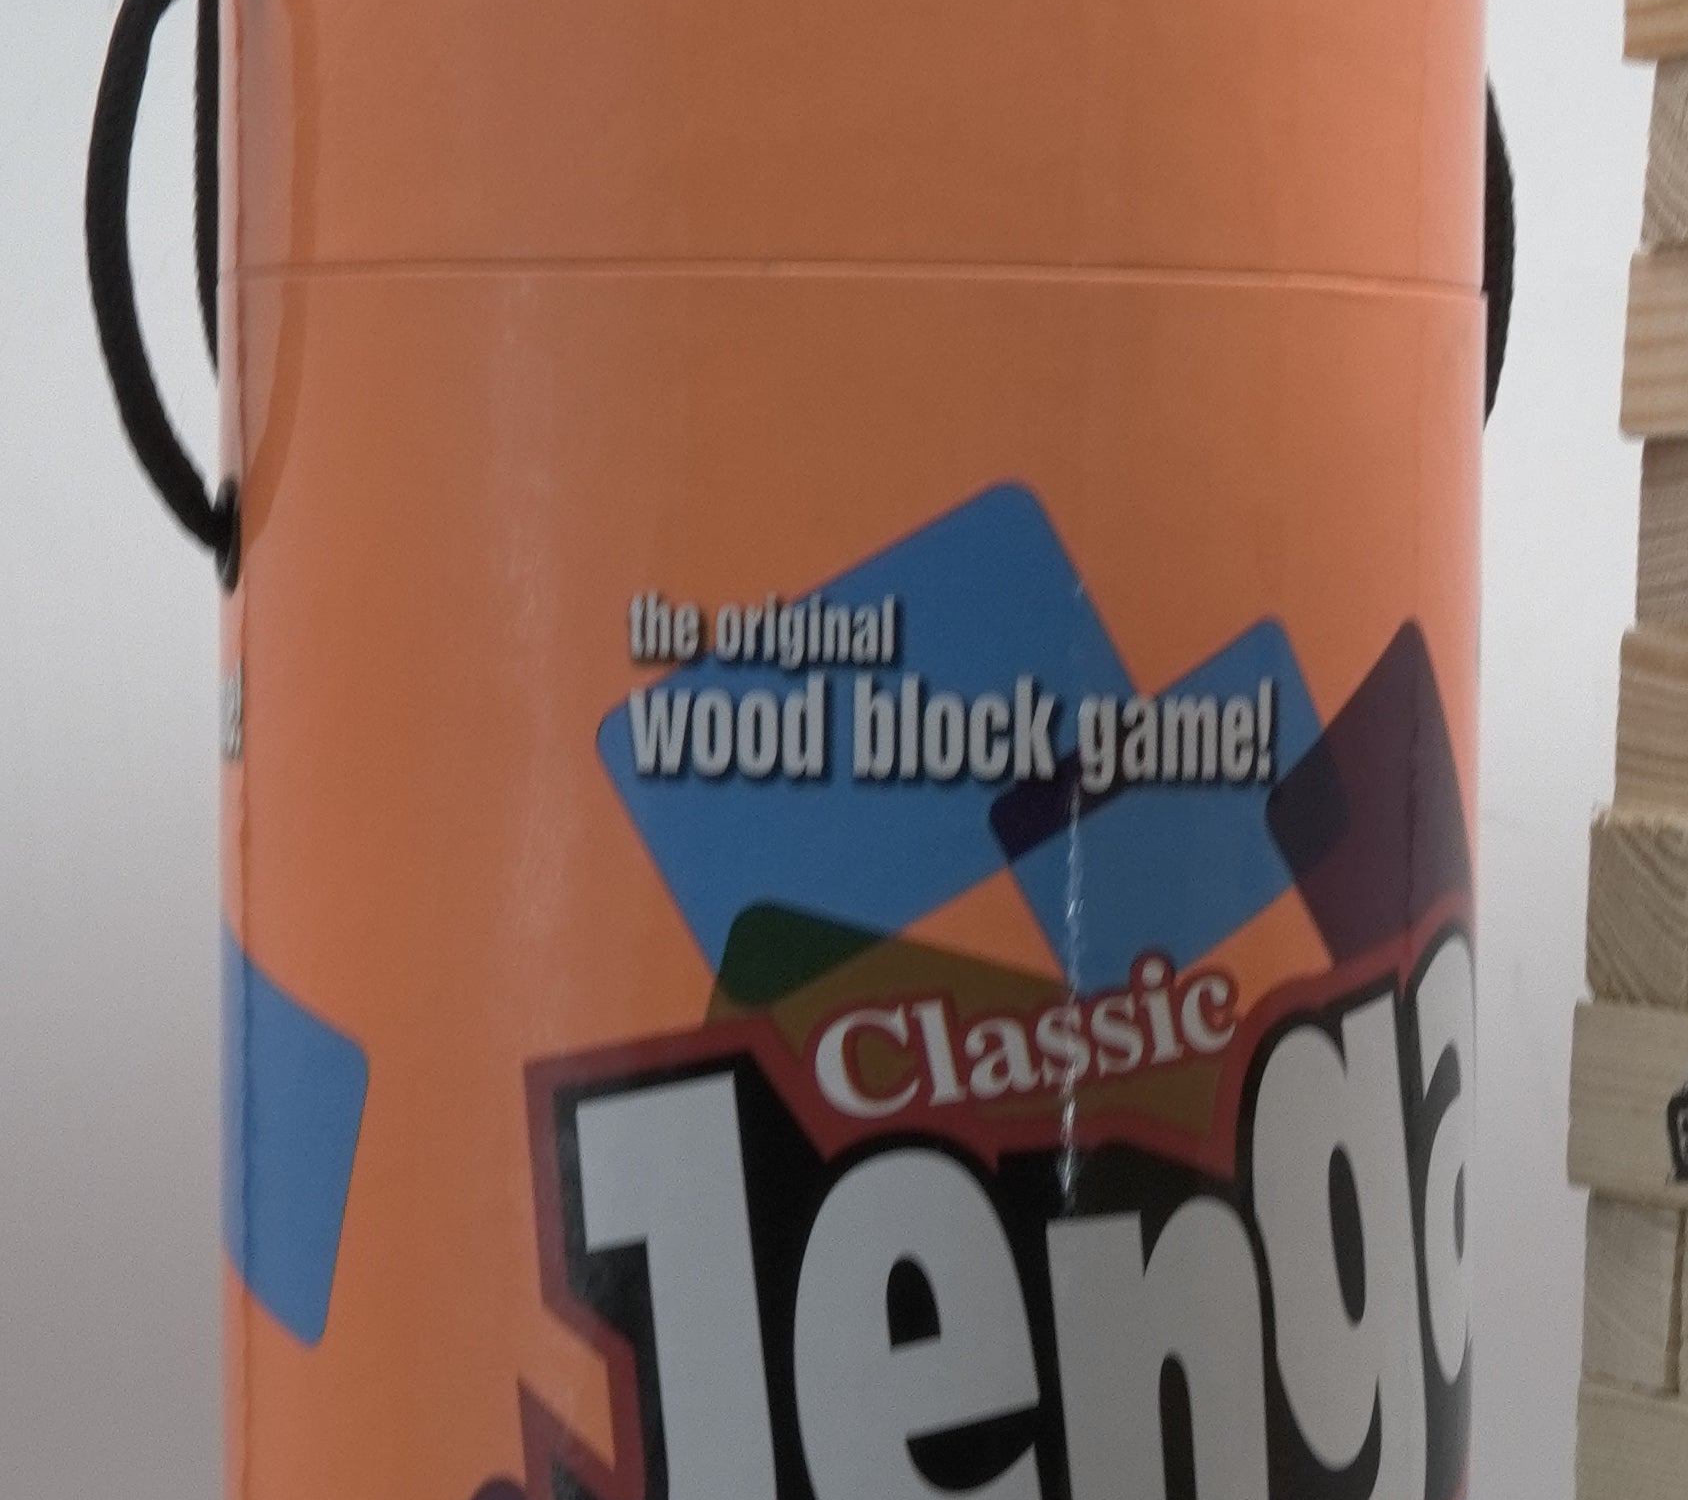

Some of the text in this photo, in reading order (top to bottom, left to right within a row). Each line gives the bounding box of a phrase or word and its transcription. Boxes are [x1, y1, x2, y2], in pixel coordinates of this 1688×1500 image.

[629, 593, 895, 670] the original
[629, 672, 1273, 794] wood block game!
[815, 958, 1237, 1118] Classic
